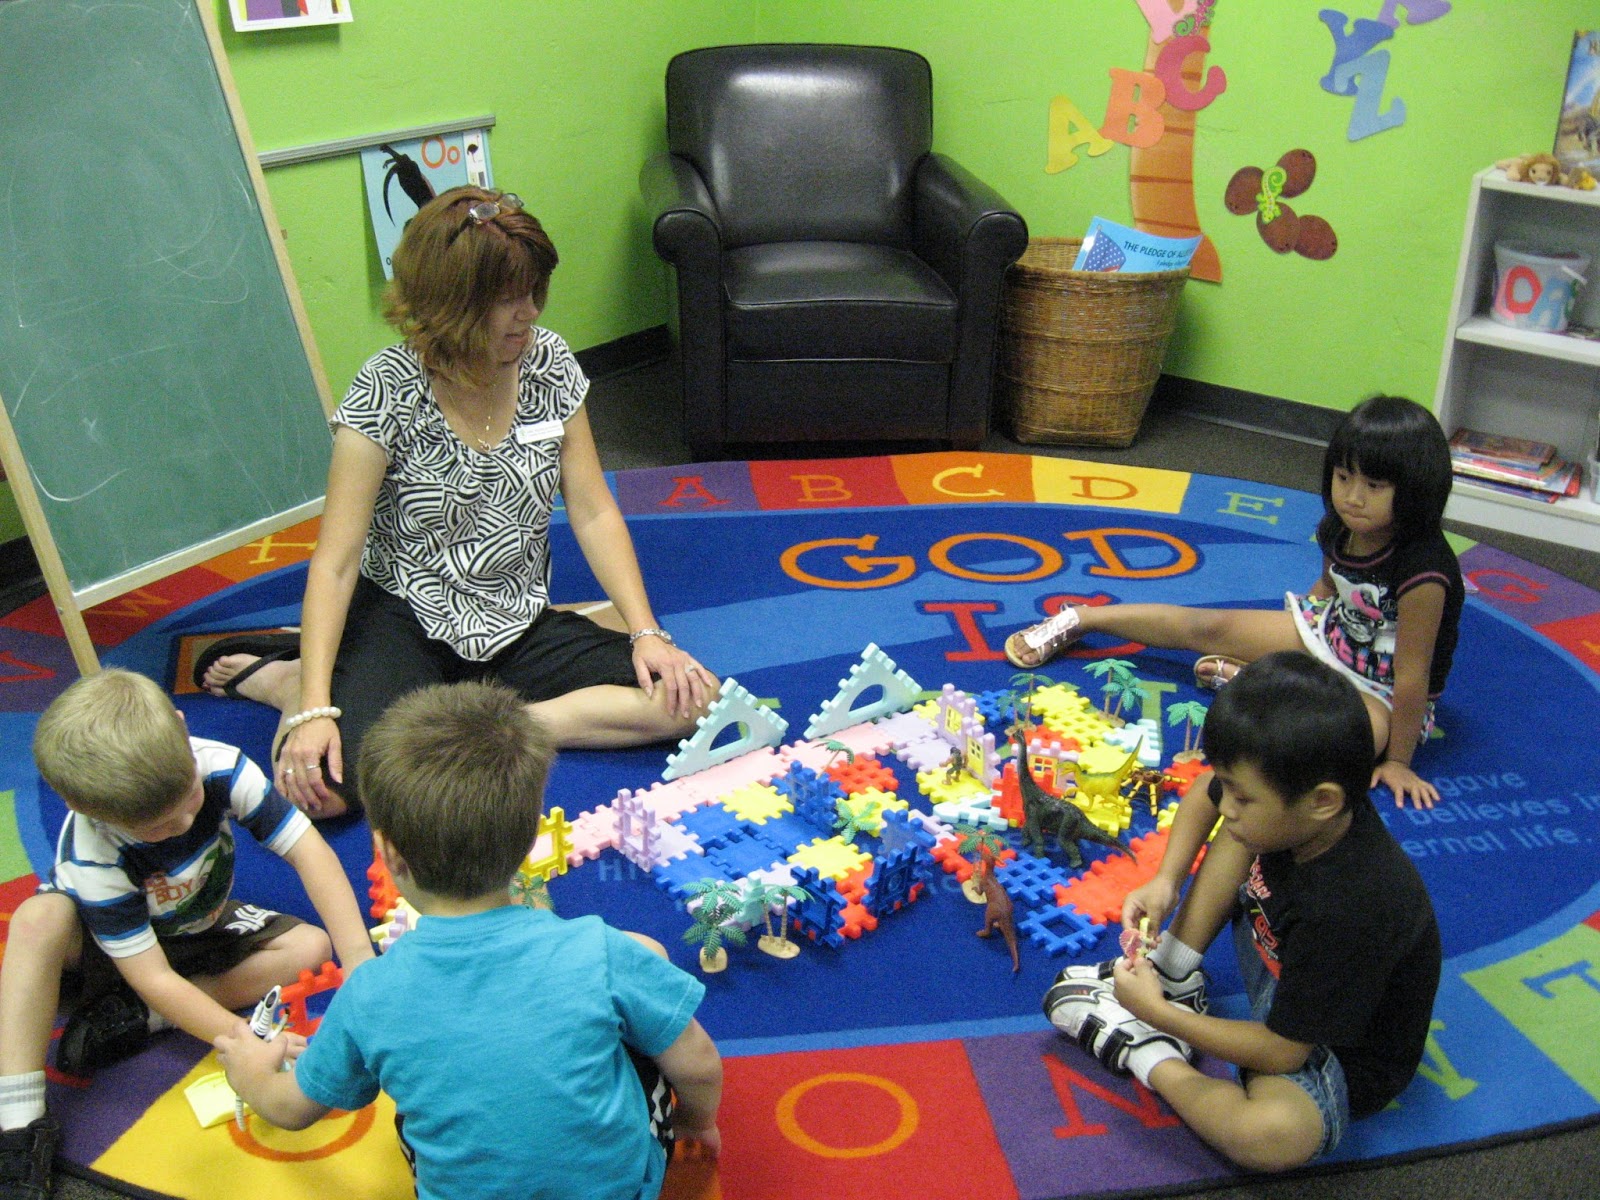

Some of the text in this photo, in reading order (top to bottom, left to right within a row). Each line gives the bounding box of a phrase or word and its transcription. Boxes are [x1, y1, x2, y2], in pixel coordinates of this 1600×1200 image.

[1124, 241, 1139, 253] THE
[1140, 245, 1165, 258] PLEDGE
[1167, 249, 1177, 258] OF
[658, 476, 733, 507] A
[789, 474, 854, 503] B
[932, 463, 1005, 498] C
[1069, 475, 1139, 501] D
[1216, 491, 1285, 526] E
[779, 527, 1198, 590] GOD
[1433, 771, 1527, 798] gave
[1401, 797, 1571, 826] believes
[1400, 830, 1507, 858] ernal
[776, 1072, 919, 1160] O
